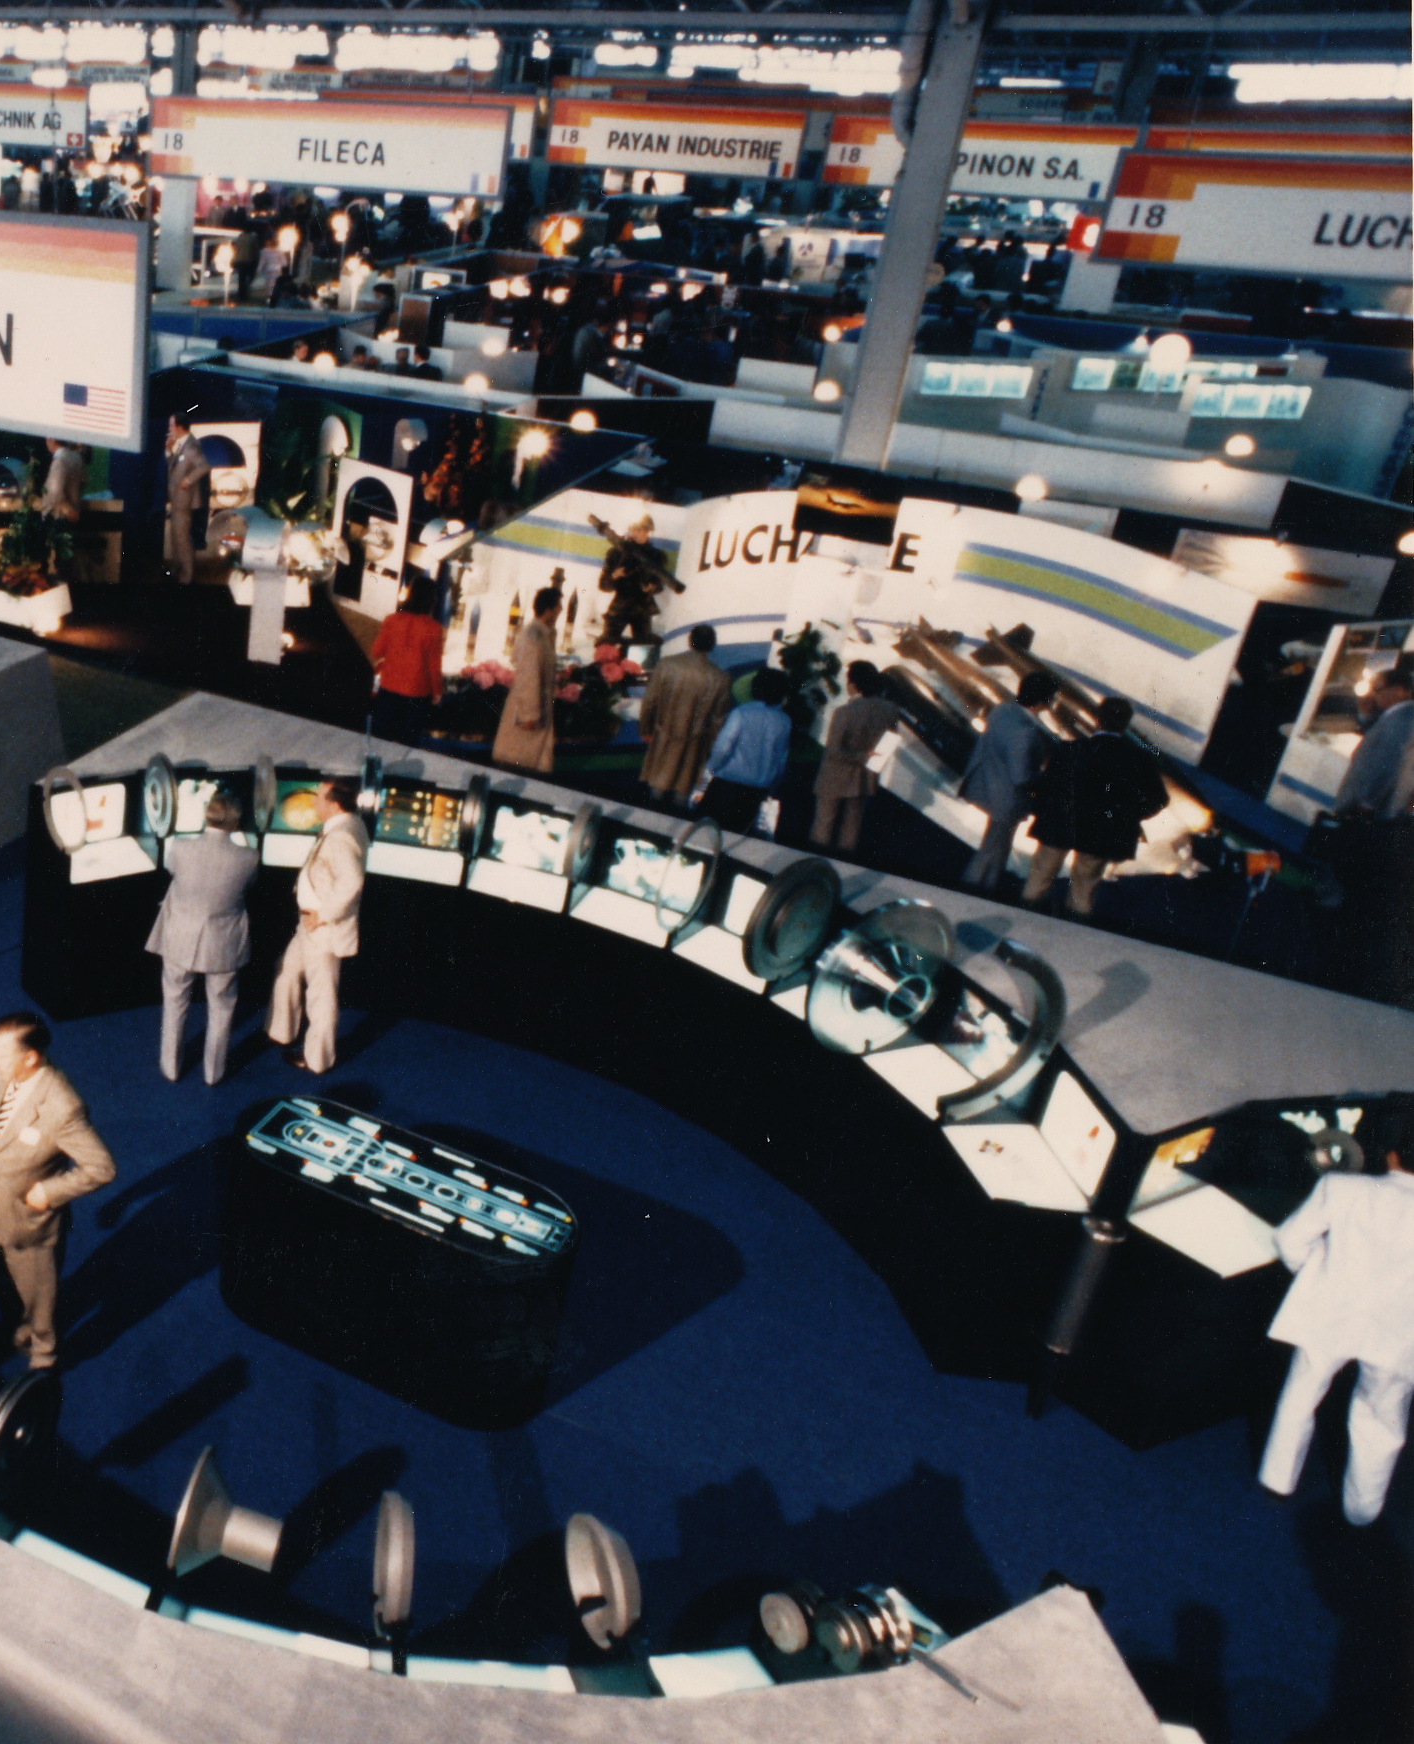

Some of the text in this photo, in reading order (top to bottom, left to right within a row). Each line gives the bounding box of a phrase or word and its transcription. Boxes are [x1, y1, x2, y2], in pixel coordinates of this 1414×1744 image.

[41, 111, 62, 130] AG
[298, 138, 385, 166] FILECA
[606, 130, 782, 161] PAYAN INDUSTRIE
